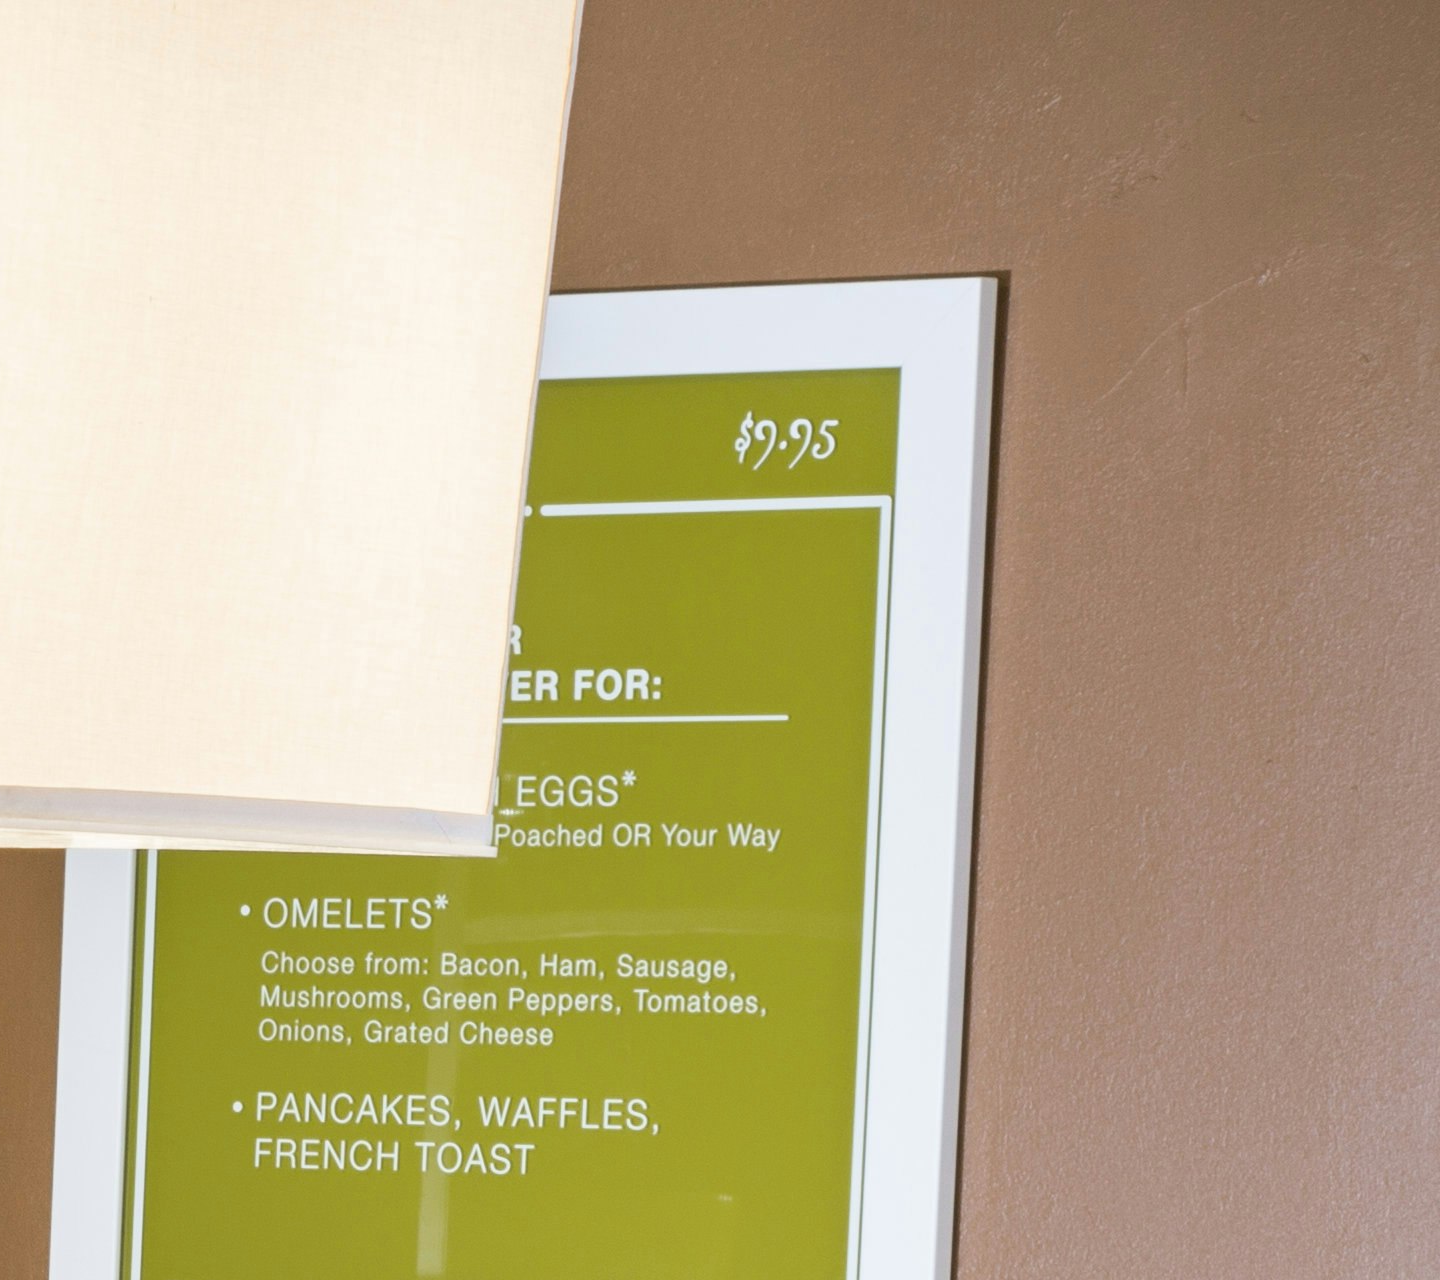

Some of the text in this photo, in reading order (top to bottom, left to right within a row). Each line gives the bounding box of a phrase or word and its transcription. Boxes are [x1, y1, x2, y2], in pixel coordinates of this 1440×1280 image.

[733, 410, 840, 471] $9.95
[573, 667, 662, 701] FOR:
[495, 822, 781, 853] Poached OR Your Way
[260, 949, 736, 984] Choose from: Bacon, Ham, Sausage,
[259, 984, 767, 1017] Mushrooms, Green Peppers, Tomatoes,
[257, 1017, 554, 1047] Onions, Grated Cheese
[255, 1090, 659, 1136] PANCAKES, WAFFLES,
[253, 1137, 536, 1176] FRENCH TOAST
